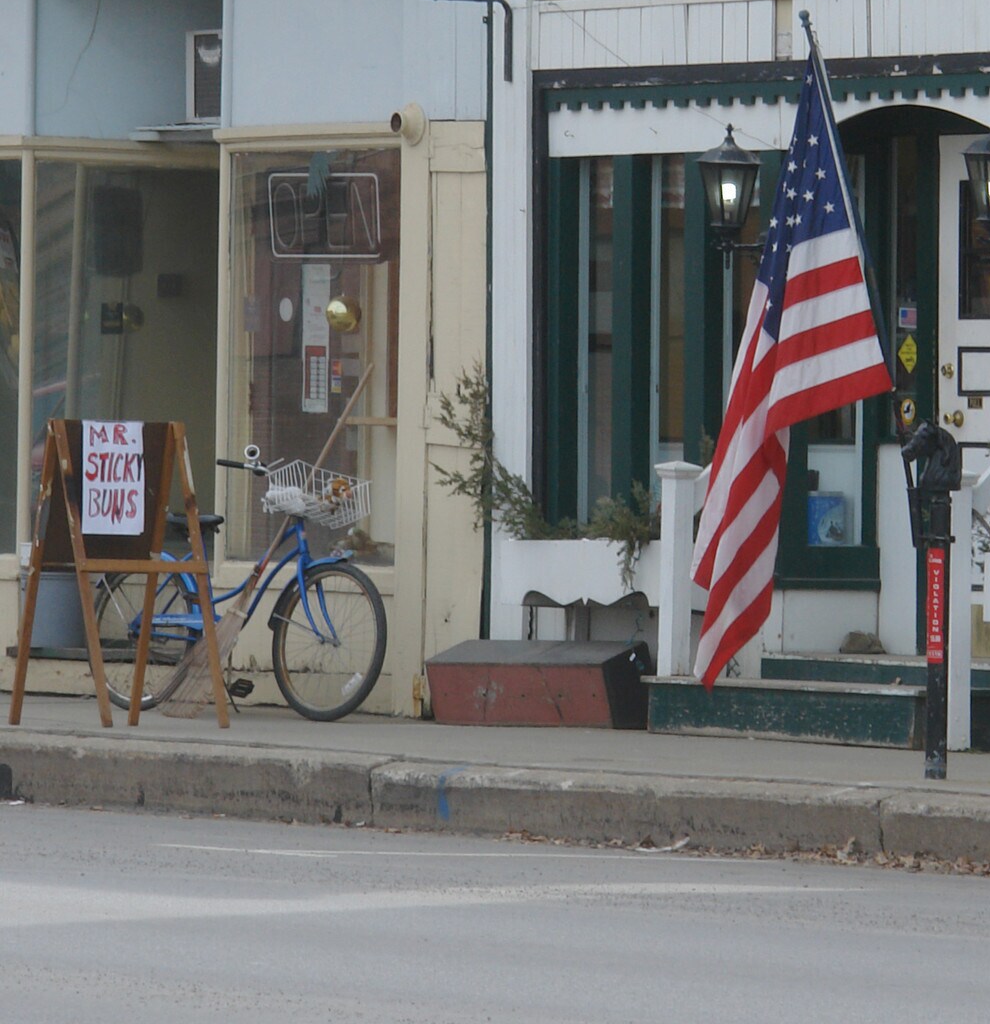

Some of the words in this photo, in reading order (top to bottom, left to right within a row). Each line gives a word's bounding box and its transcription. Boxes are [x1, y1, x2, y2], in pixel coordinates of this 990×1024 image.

[273, 181, 376, 249] OPEN
[89, 424, 136, 447] MR.
[85, 452, 144, 482] STICKY
[88, 488, 138, 525] BUNS
[932, 569, 940, 633] VIOLATION
